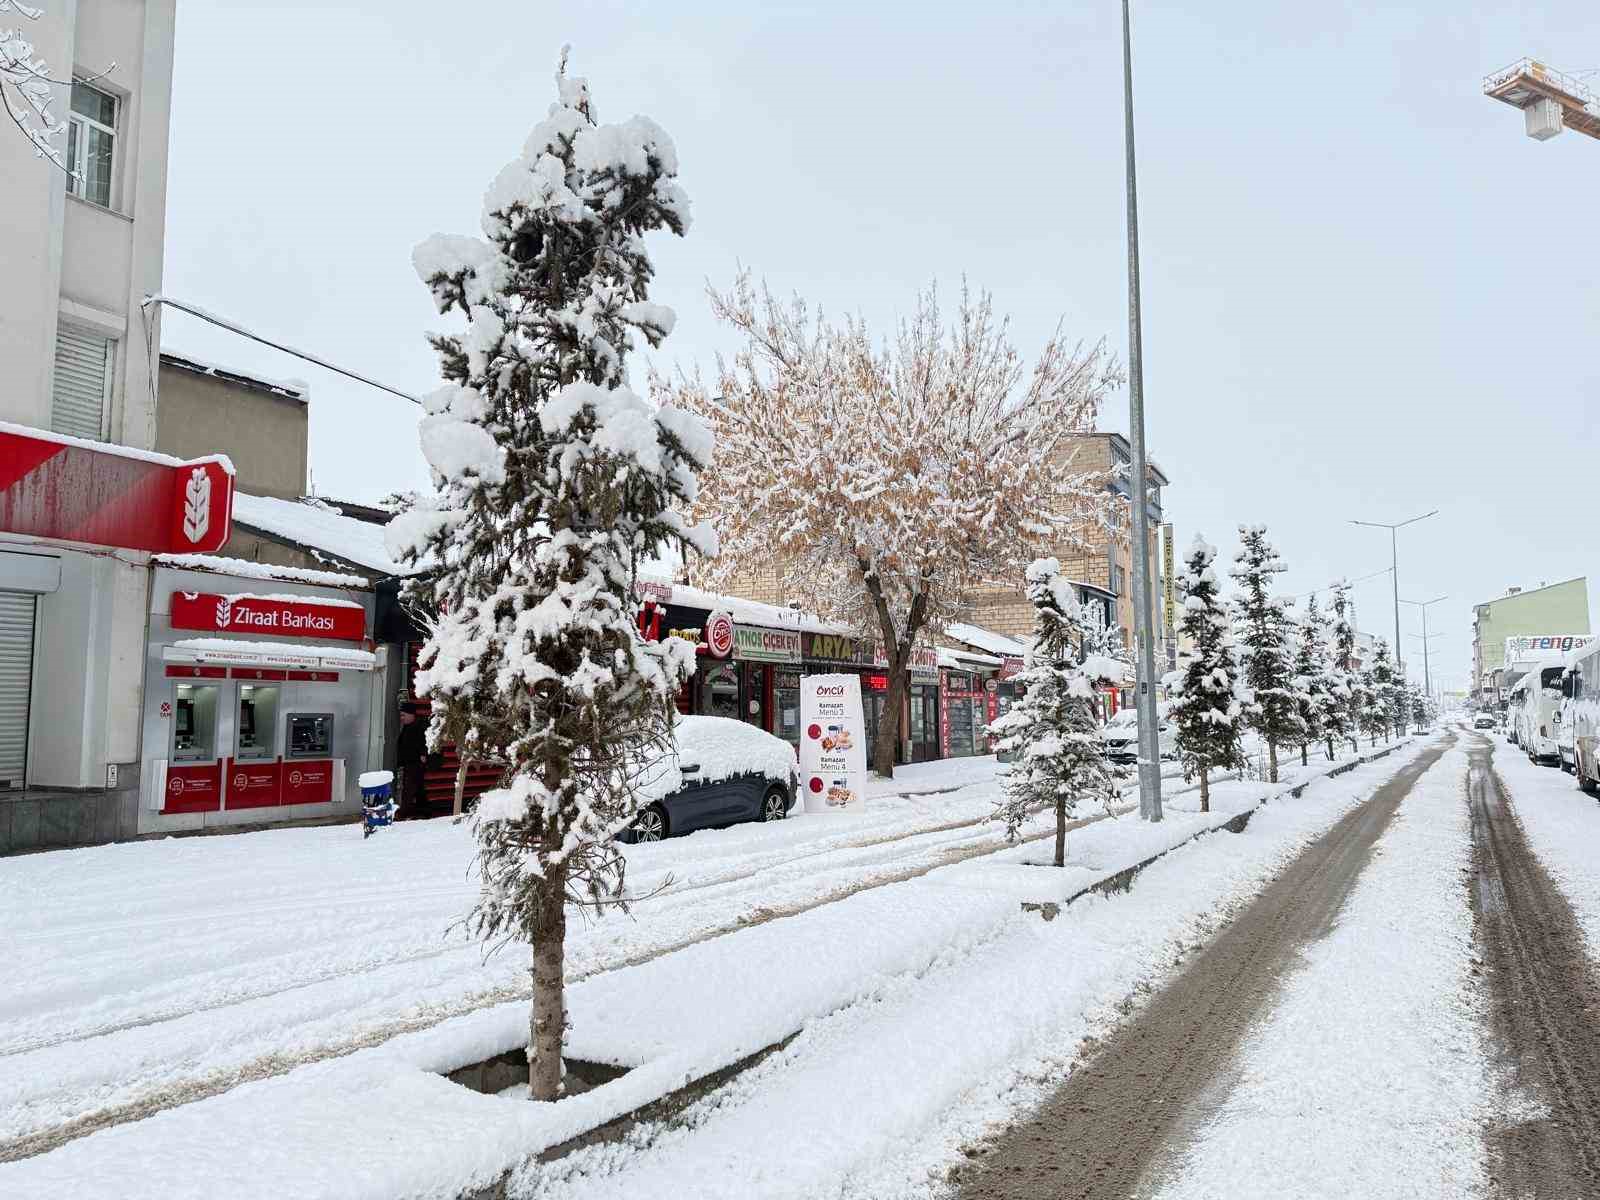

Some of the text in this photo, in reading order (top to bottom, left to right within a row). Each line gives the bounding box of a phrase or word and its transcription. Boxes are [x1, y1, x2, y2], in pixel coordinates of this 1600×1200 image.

[235, 606, 334, 630] Ziraat Bankası
[812, 635, 852, 658] ARYA
